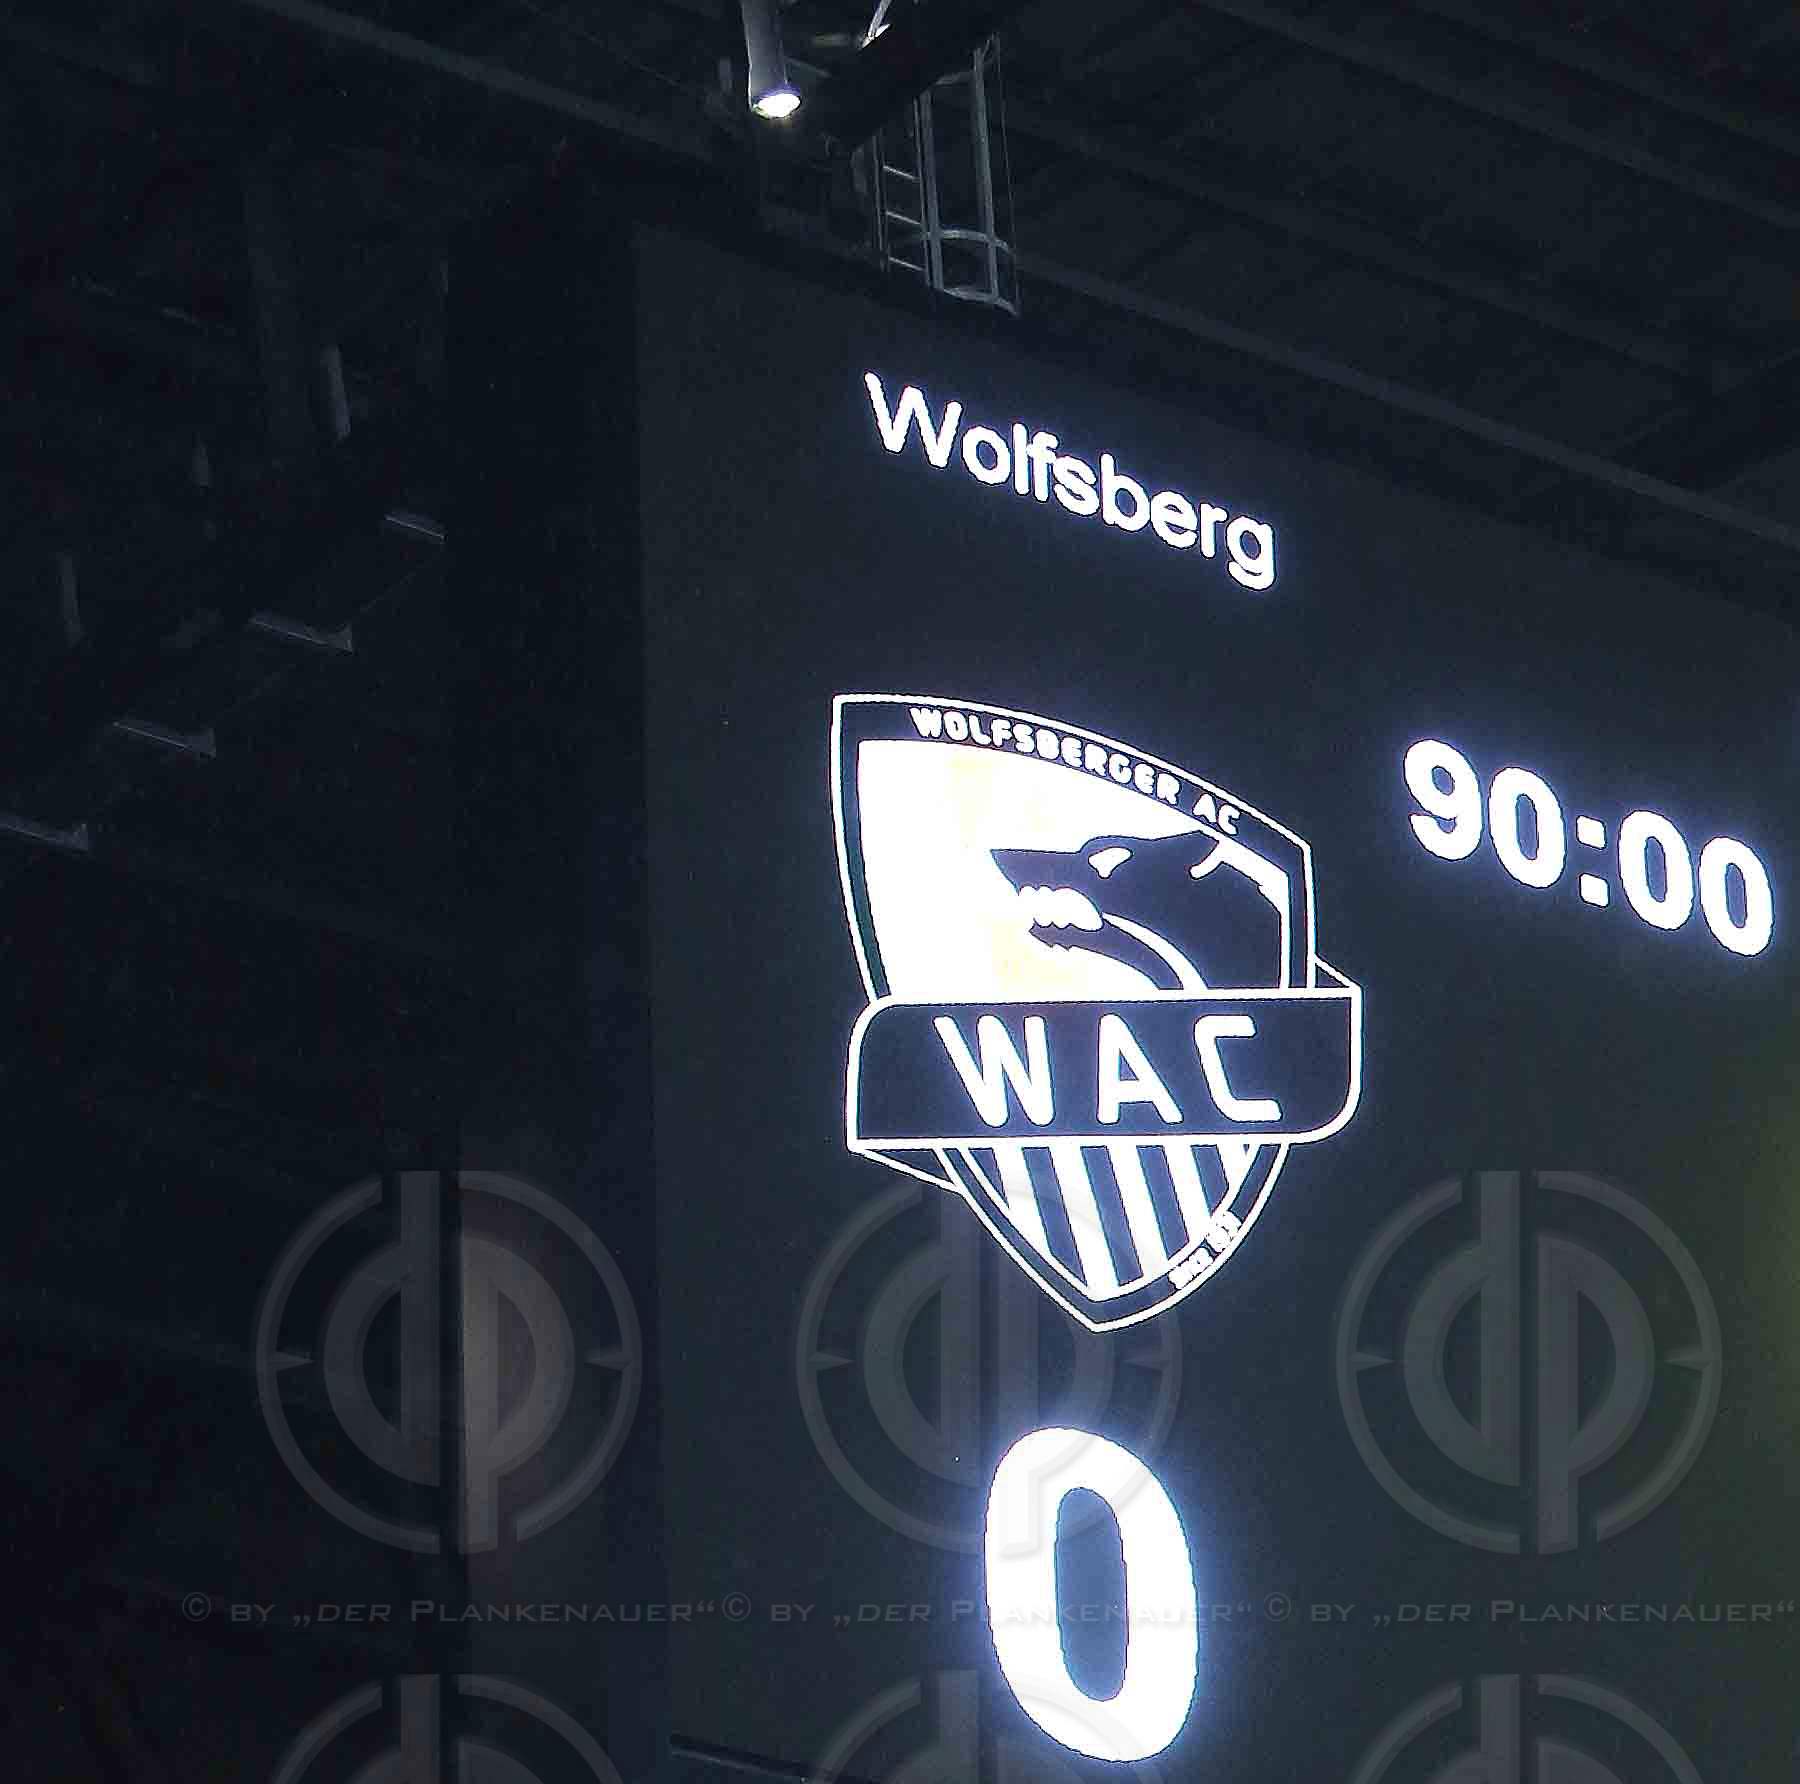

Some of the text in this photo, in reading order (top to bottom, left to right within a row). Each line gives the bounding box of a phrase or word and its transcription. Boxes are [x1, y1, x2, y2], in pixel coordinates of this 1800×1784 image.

[866, 371, 1281, 593] Wolfsberg
[911, 707, 1243, 838] WOLFSBERGER AC
[1404, 737, 1777, 958] 90:00
[934, 1013, 1284, 1129] WAC
[983, 1425, 1203, 1763] 0
